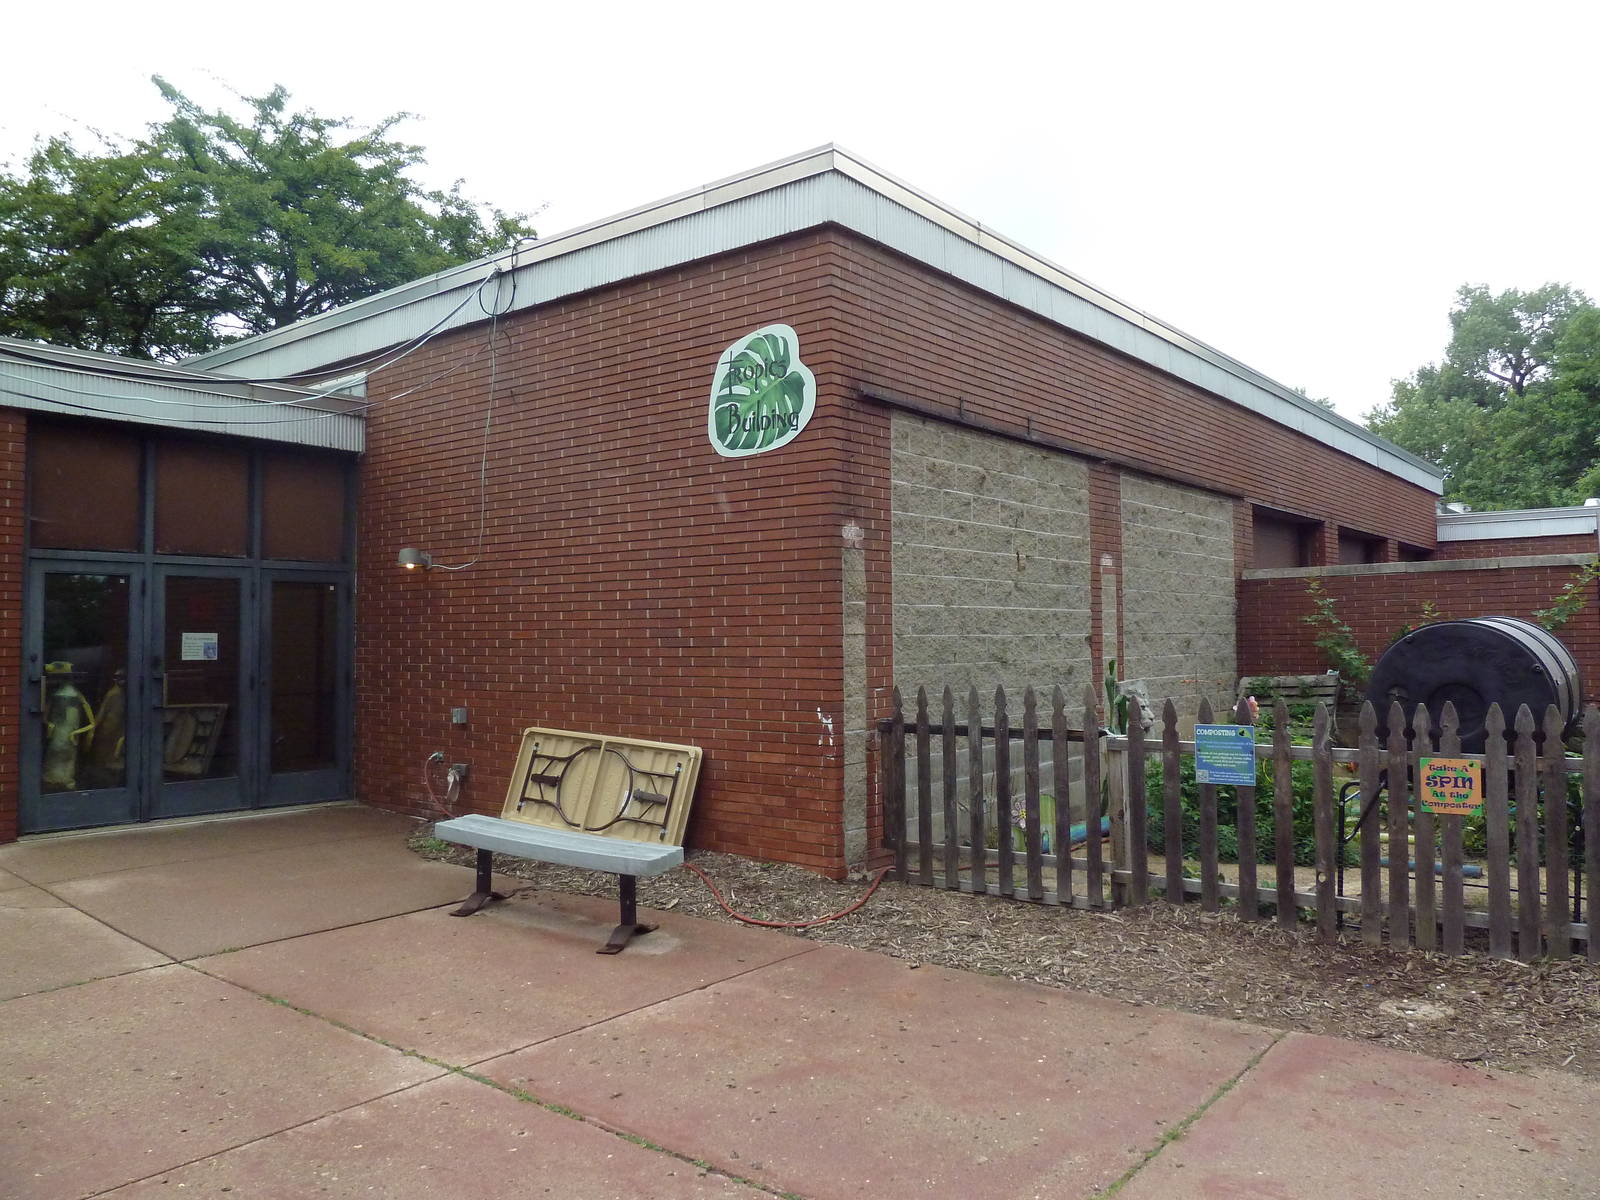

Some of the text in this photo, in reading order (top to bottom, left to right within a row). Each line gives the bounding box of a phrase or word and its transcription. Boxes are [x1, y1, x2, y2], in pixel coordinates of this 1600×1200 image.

[1196, 728, 1236, 737] COMPOSTING
[1428, 764, 1457, 772] Take
[1449, 791, 1469, 799] the
